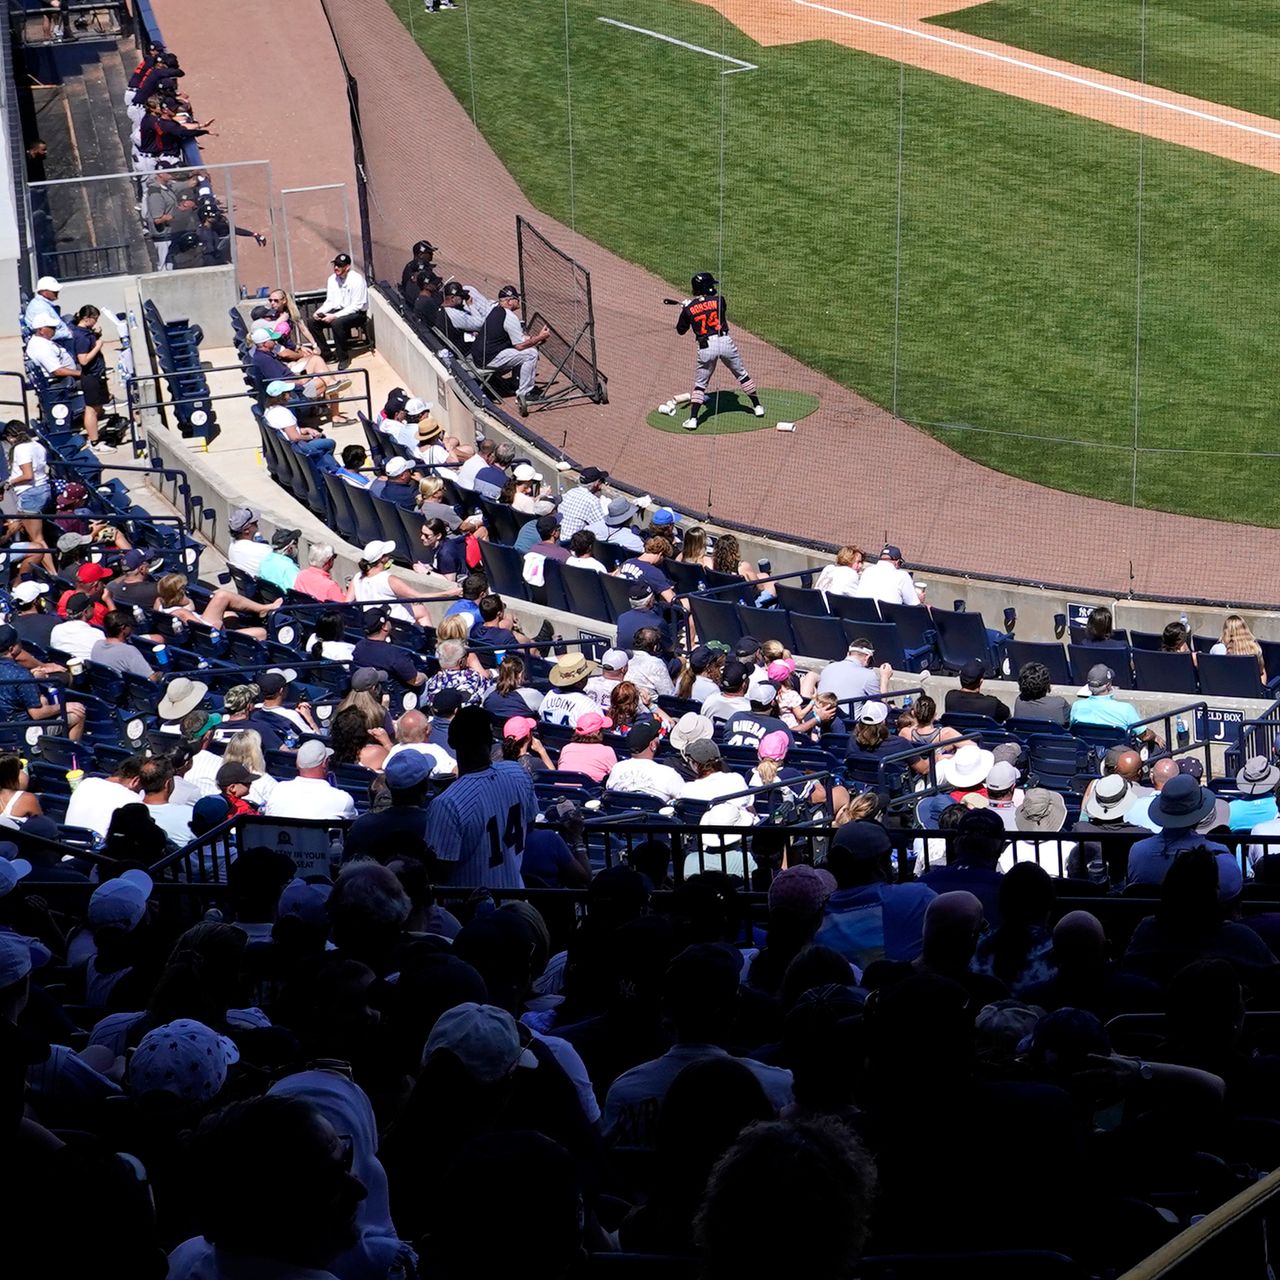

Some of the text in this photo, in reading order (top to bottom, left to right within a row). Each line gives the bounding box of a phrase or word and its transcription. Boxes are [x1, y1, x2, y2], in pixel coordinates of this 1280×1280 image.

[694, 311, 721, 335] 74
[1197, 709, 1241, 722] FELD BOX
[732, 719, 767, 738] RIVERA
[1213, 722, 1224, 740] J
[487, 802, 527, 869] 14
[291, 851, 327, 860] IN YOUR
